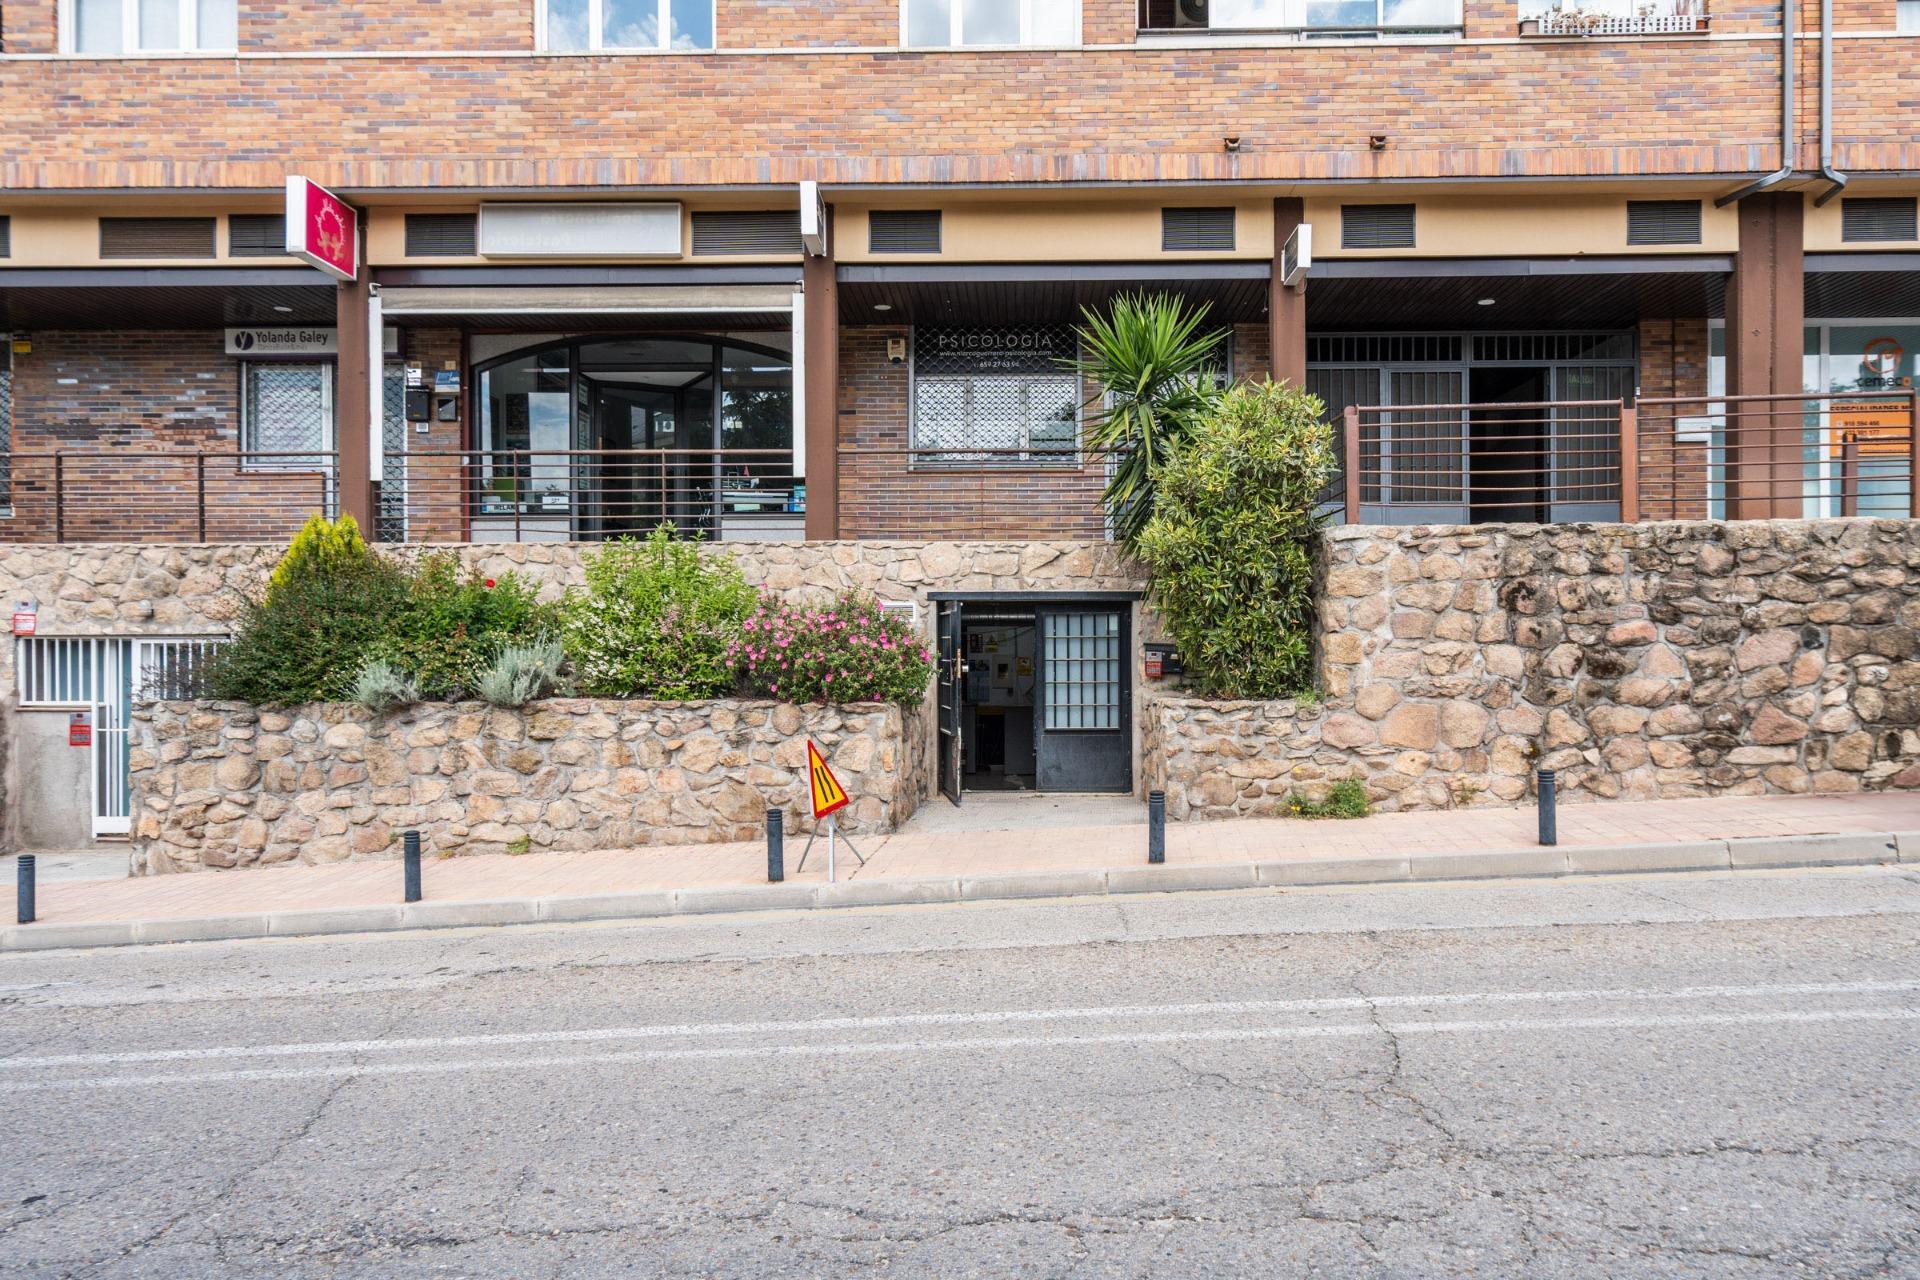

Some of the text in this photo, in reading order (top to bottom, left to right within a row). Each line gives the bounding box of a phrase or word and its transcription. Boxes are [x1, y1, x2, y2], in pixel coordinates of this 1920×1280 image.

[255, 331, 328, 345] Yolanda Galey
[938, 332, 1053, 348] PSICOLOGÍA
[1856, 376, 1912, 387] cemeco
